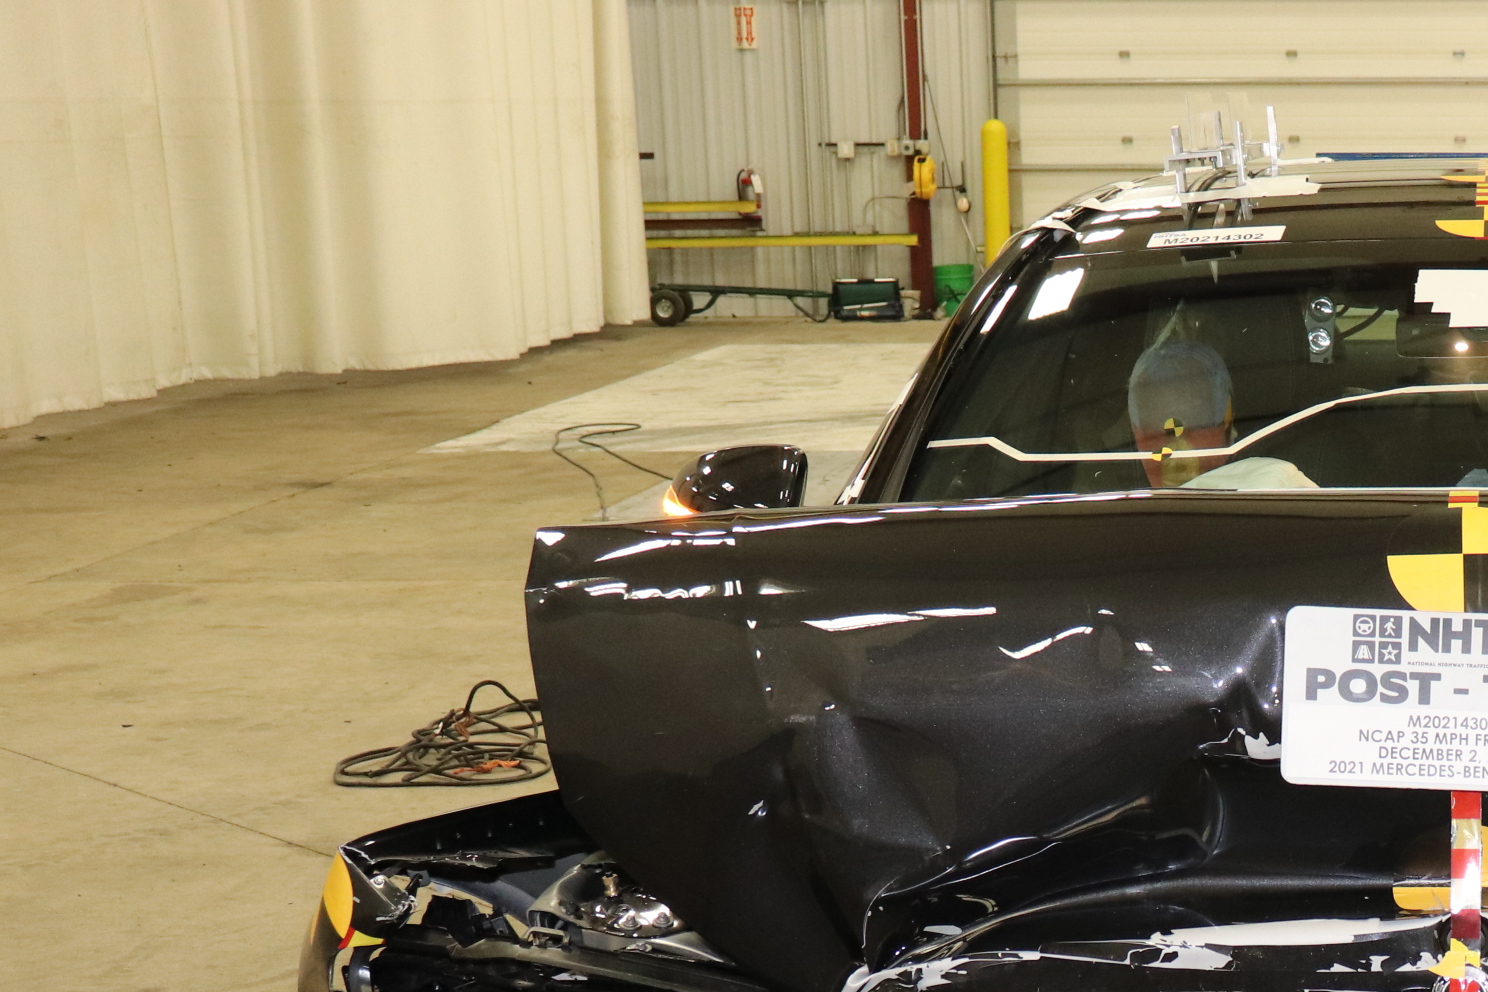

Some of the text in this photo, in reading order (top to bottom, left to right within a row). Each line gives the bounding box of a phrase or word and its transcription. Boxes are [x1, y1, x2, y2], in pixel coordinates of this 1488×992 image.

[1163, 233, 1264, 245] M20214302
[1305, 667, 1442, 706] POST
[1358, 729, 1405, 743] NCAP
[1410, 730, 1429, 745] 35
[1433, 732, 1469, 746] MPH
[1378, 745, 1463, 762] DECEMBER
[1468, 749, 1481, 764] 2,
[1328, 760, 1364, 774] 2021
